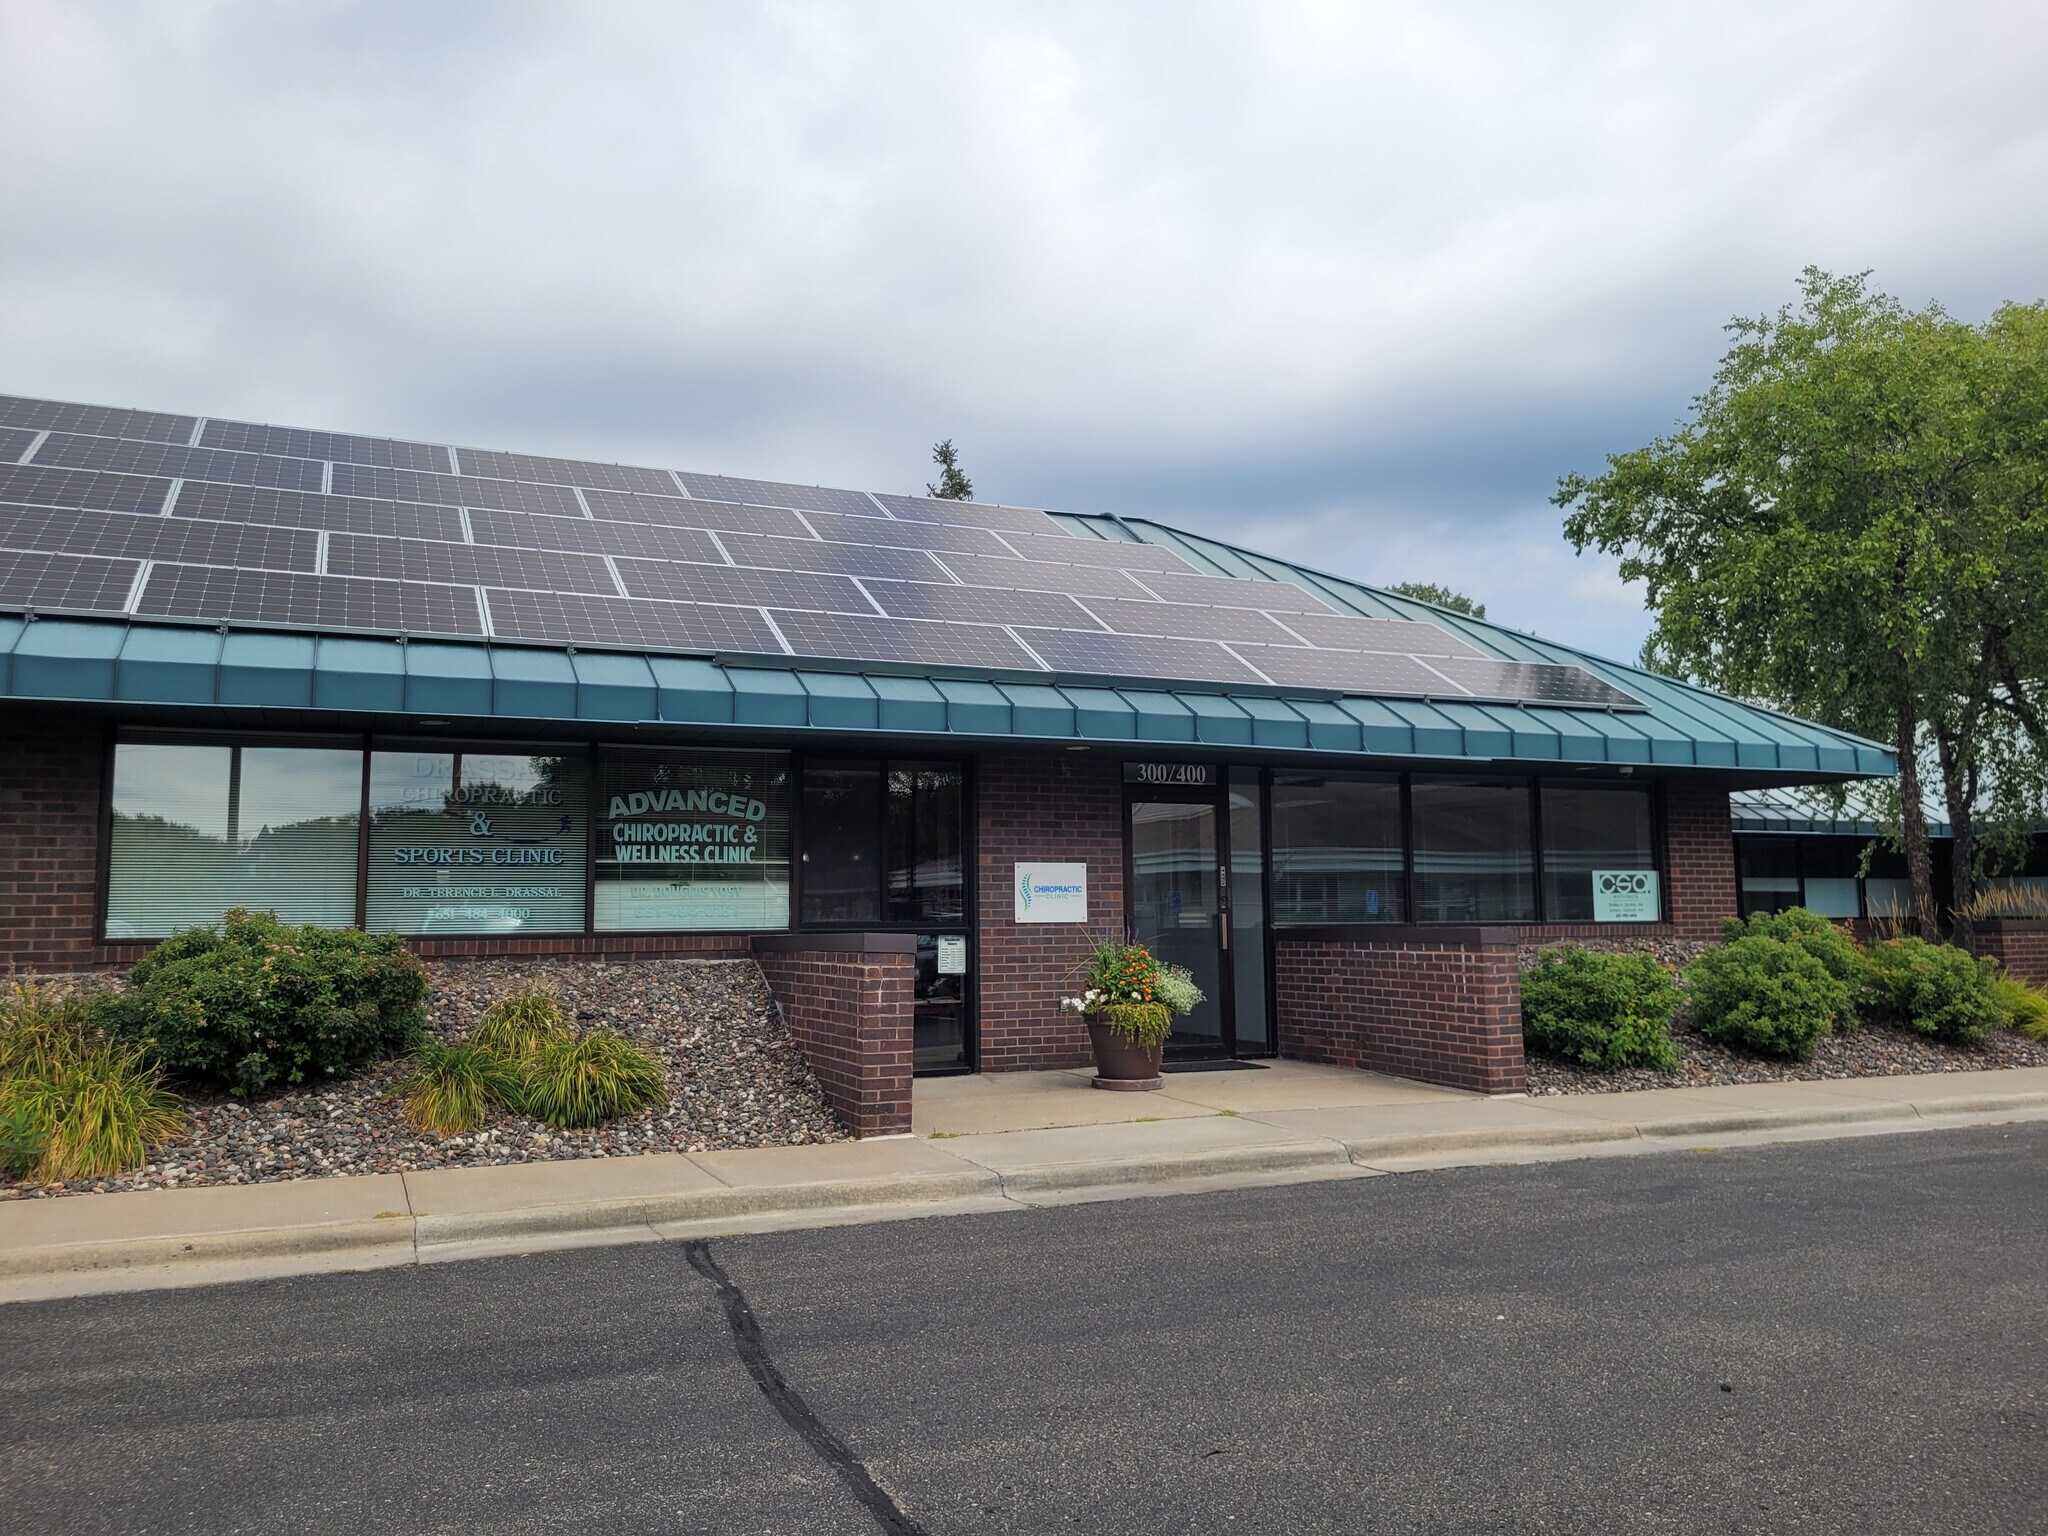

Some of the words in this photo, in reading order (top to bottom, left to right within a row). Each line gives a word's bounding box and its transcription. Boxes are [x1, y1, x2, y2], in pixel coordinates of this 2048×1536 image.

[412, 757, 553, 782] DRASSA
[1137, 763, 1206, 783] 300/400
[608, 789, 767, 822] ADVANCED
[469, 811, 493, 836] &
[613, 823, 739, 843] CHIROPRACTIC
[743, 824, 758, 843] &
[394, 847, 484, 864] SPORTS
[491, 848, 563, 865] CLINIC
[615, 845, 700, 863] WELLNESS
[704, 846, 756, 864] CLINIC
[428, 887, 487, 898] TERENCE
[505, 887, 562, 898] DRASSAL
[1034, 885, 1082, 893] CHIROPRACTIC
